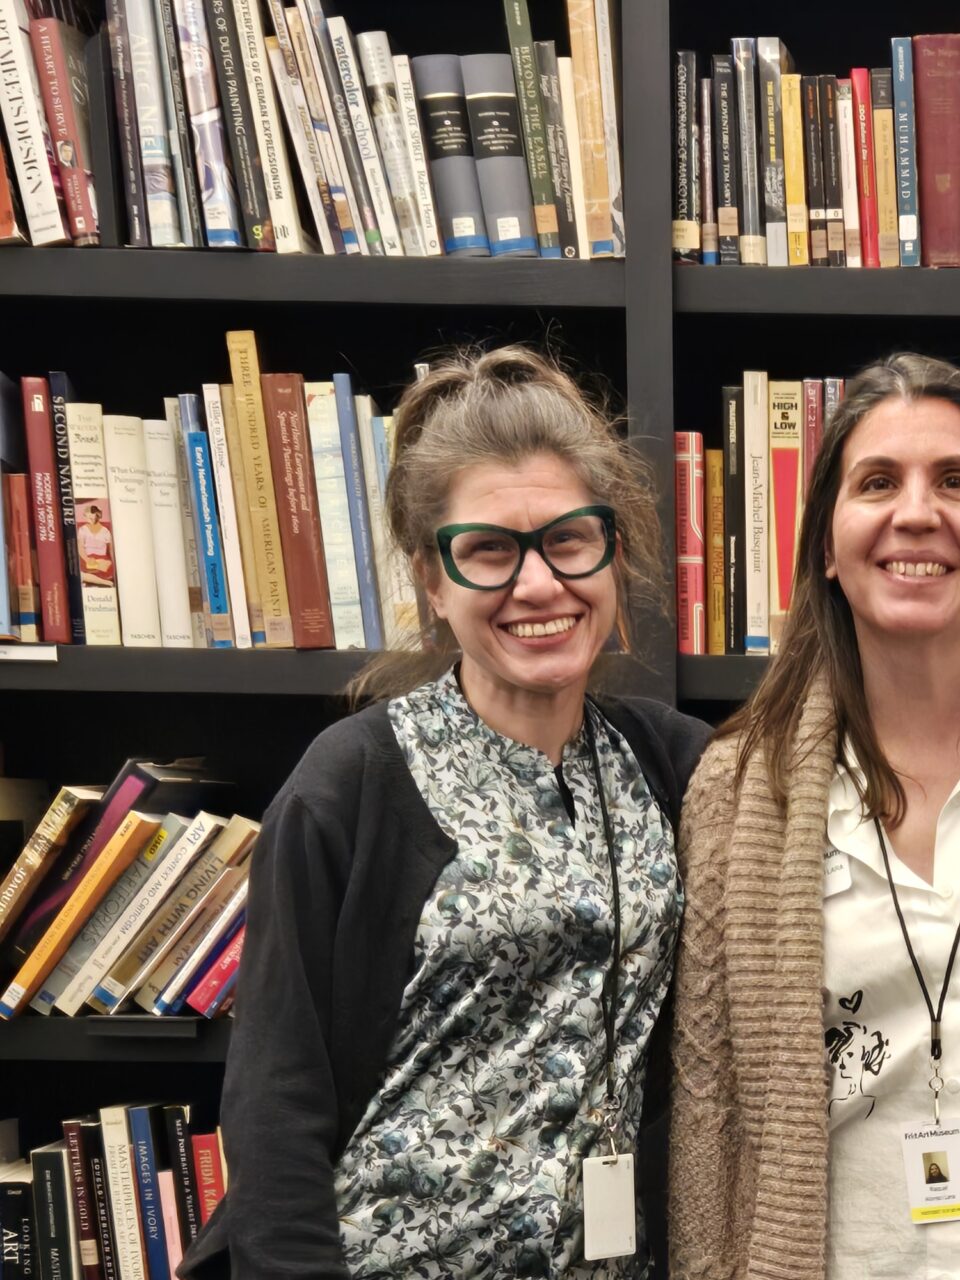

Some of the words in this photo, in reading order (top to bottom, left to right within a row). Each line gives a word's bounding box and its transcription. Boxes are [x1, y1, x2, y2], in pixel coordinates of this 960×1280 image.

[39, 24, 48, 34] A
[215, 16, 228, 33] OF
[41, 36, 56, 74] HEART
[219, 35, 236, 76] DUTCH
[252, 62, 261, 73] OF
[520, 45, 537, 98] BEYOND
[49, 79, 60, 94] TO
[254, 76, 270, 122] GERMAN
[334, 36, 363, 109] watercolor
[352, 112, 376, 161] school
[400, 79, 413, 102] THE
[676, 64, 688, 145] CONTEMPORARIES
[720, 81, 728, 98] THE
[0, 50, 27, 120] MEETS
[14, 119, 44, 196] DESIGN
[52, 96, 67, 136] SERVE
[227, 80, 247, 136] PAINTING
[404, 105, 417, 128] ART
[528, 104, 541, 130] THE
[721, 99, 729, 148] ADVENTURES
[262, 120, 283, 200] EXPRESSIONISM
[409, 129, 423, 162] SPIRIT
[533, 135, 548, 178] EASEL
[678, 147, 688, 162] OF
[899, 112, 911, 199] MUHAMMAD
[678, 162, 688, 197] MARCO
[239, 348, 253, 389] THREE
[244, 391, 261, 450] HUNDRED
[772, 402, 799, 410] HIGH
[52, 396, 69, 459] SECOND
[773, 421, 797, 430] LOW
[251, 453, 266, 491] YEARS
[750, 454, 763, 522] Jean-Michel
[57, 464, 75, 526] NATURE
[711, 496, 722, 538] ENGINE
[750, 525, 764, 572] Basquiat
[146, 833, 165, 856] USED
[184, 820, 207, 847] ART
[158, 846, 189, 883] CONTEXT
[184, 854, 224, 901] LIVING
[146, 879, 165, 900] AND
[118, 896, 152, 937] CRITICISM
[156, 899, 189, 938] WITH
[134, 935, 161, 966] ART
[68, 1132, 83, 1183] LETTERS
[136, 1140, 151, 1184] IMAGES
[198, 1149, 214, 1185] FRIDA
[75, 1186, 85, 1200] IN
[118, 1144, 137, 1229] MASTERPIECES
[128, 1232, 139, 1250] OF
[143, 1188, 154, 1201] IN
[77, 1201, 89, 1231] GOLD
[146, 1204, 159, 1240] IVORY
[1, 1227, 21, 1264] ART
[21, 1218, 33, 1274] LOOKING
